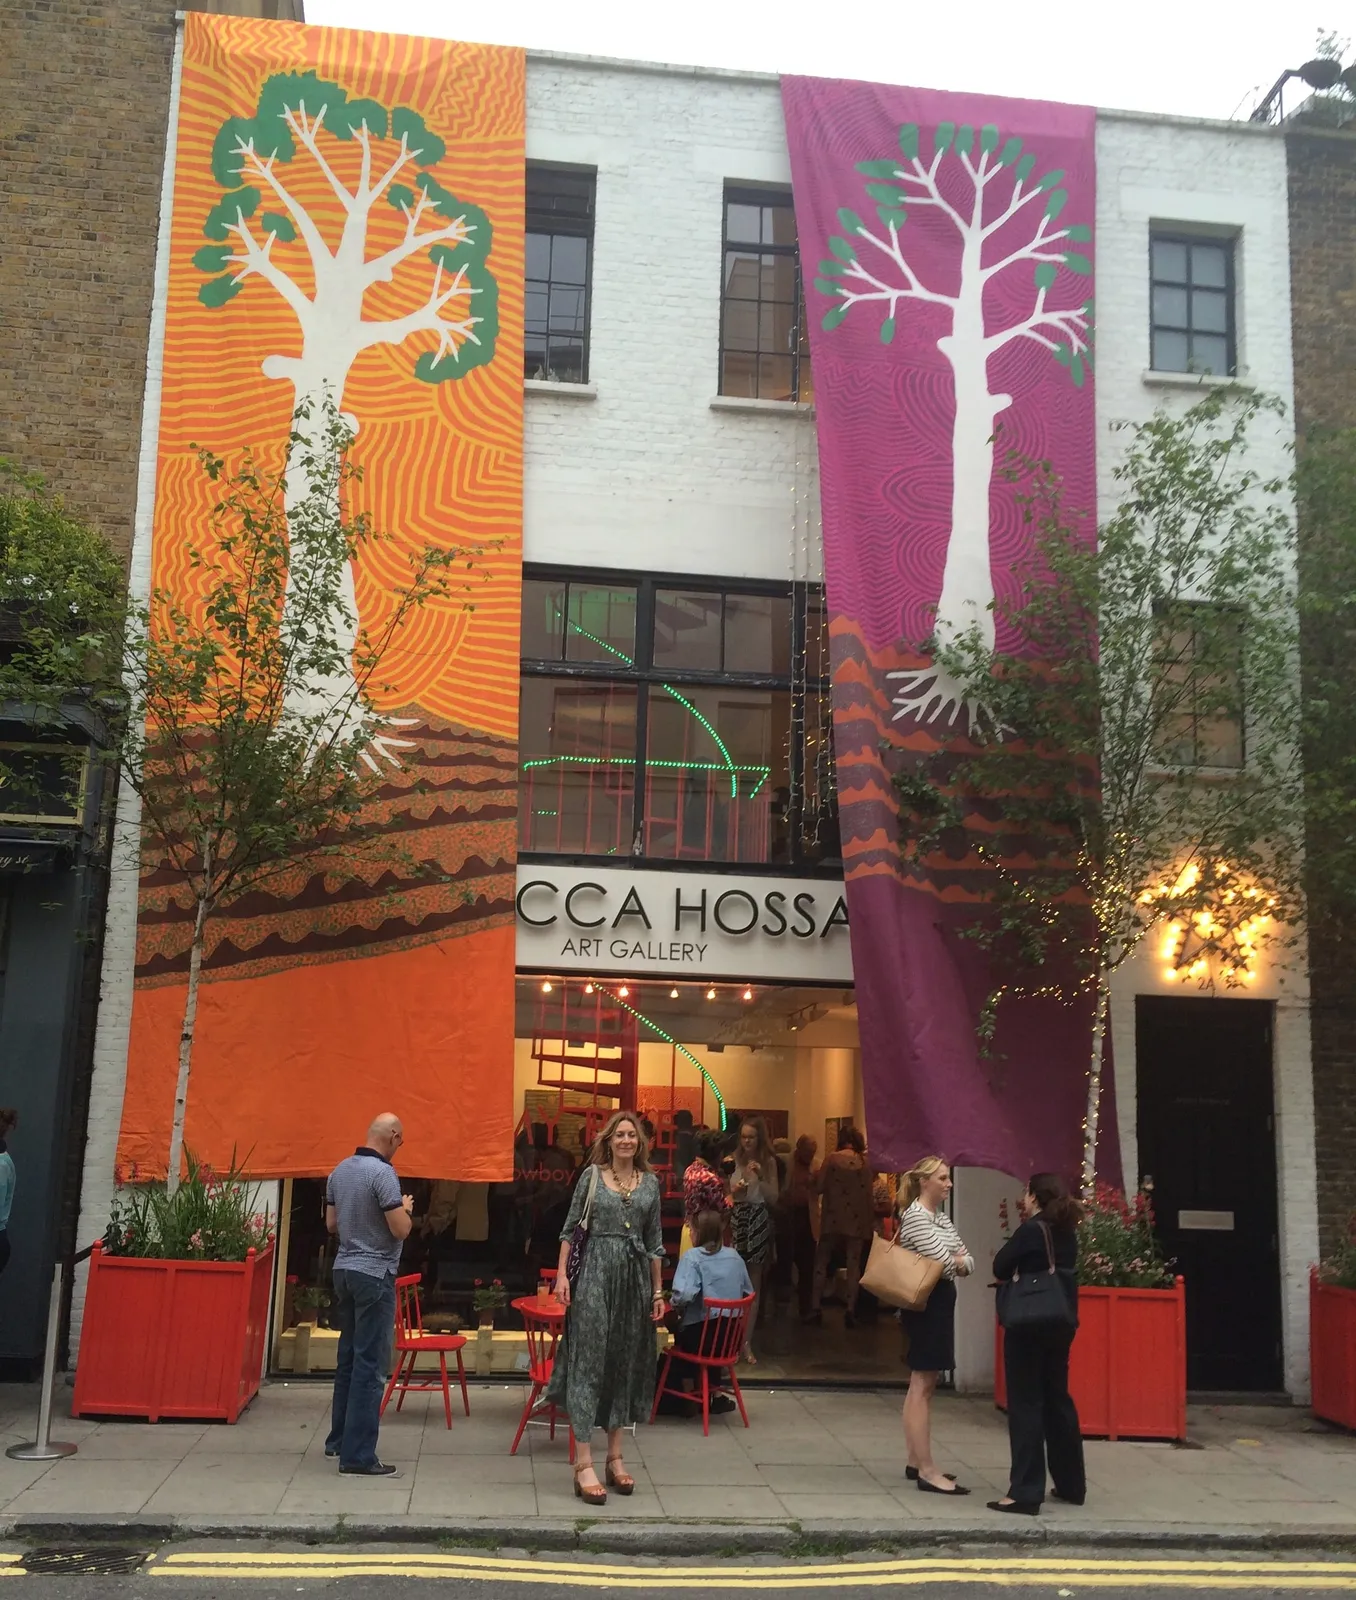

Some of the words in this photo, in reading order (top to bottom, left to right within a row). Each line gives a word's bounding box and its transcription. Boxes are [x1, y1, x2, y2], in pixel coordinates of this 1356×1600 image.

[516, 880, 652, 930] CCA
[675, 887, 851, 939] HOSSA
[560, 938, 603, 957] ART
[609, 940, 708, 962] GALLERY
